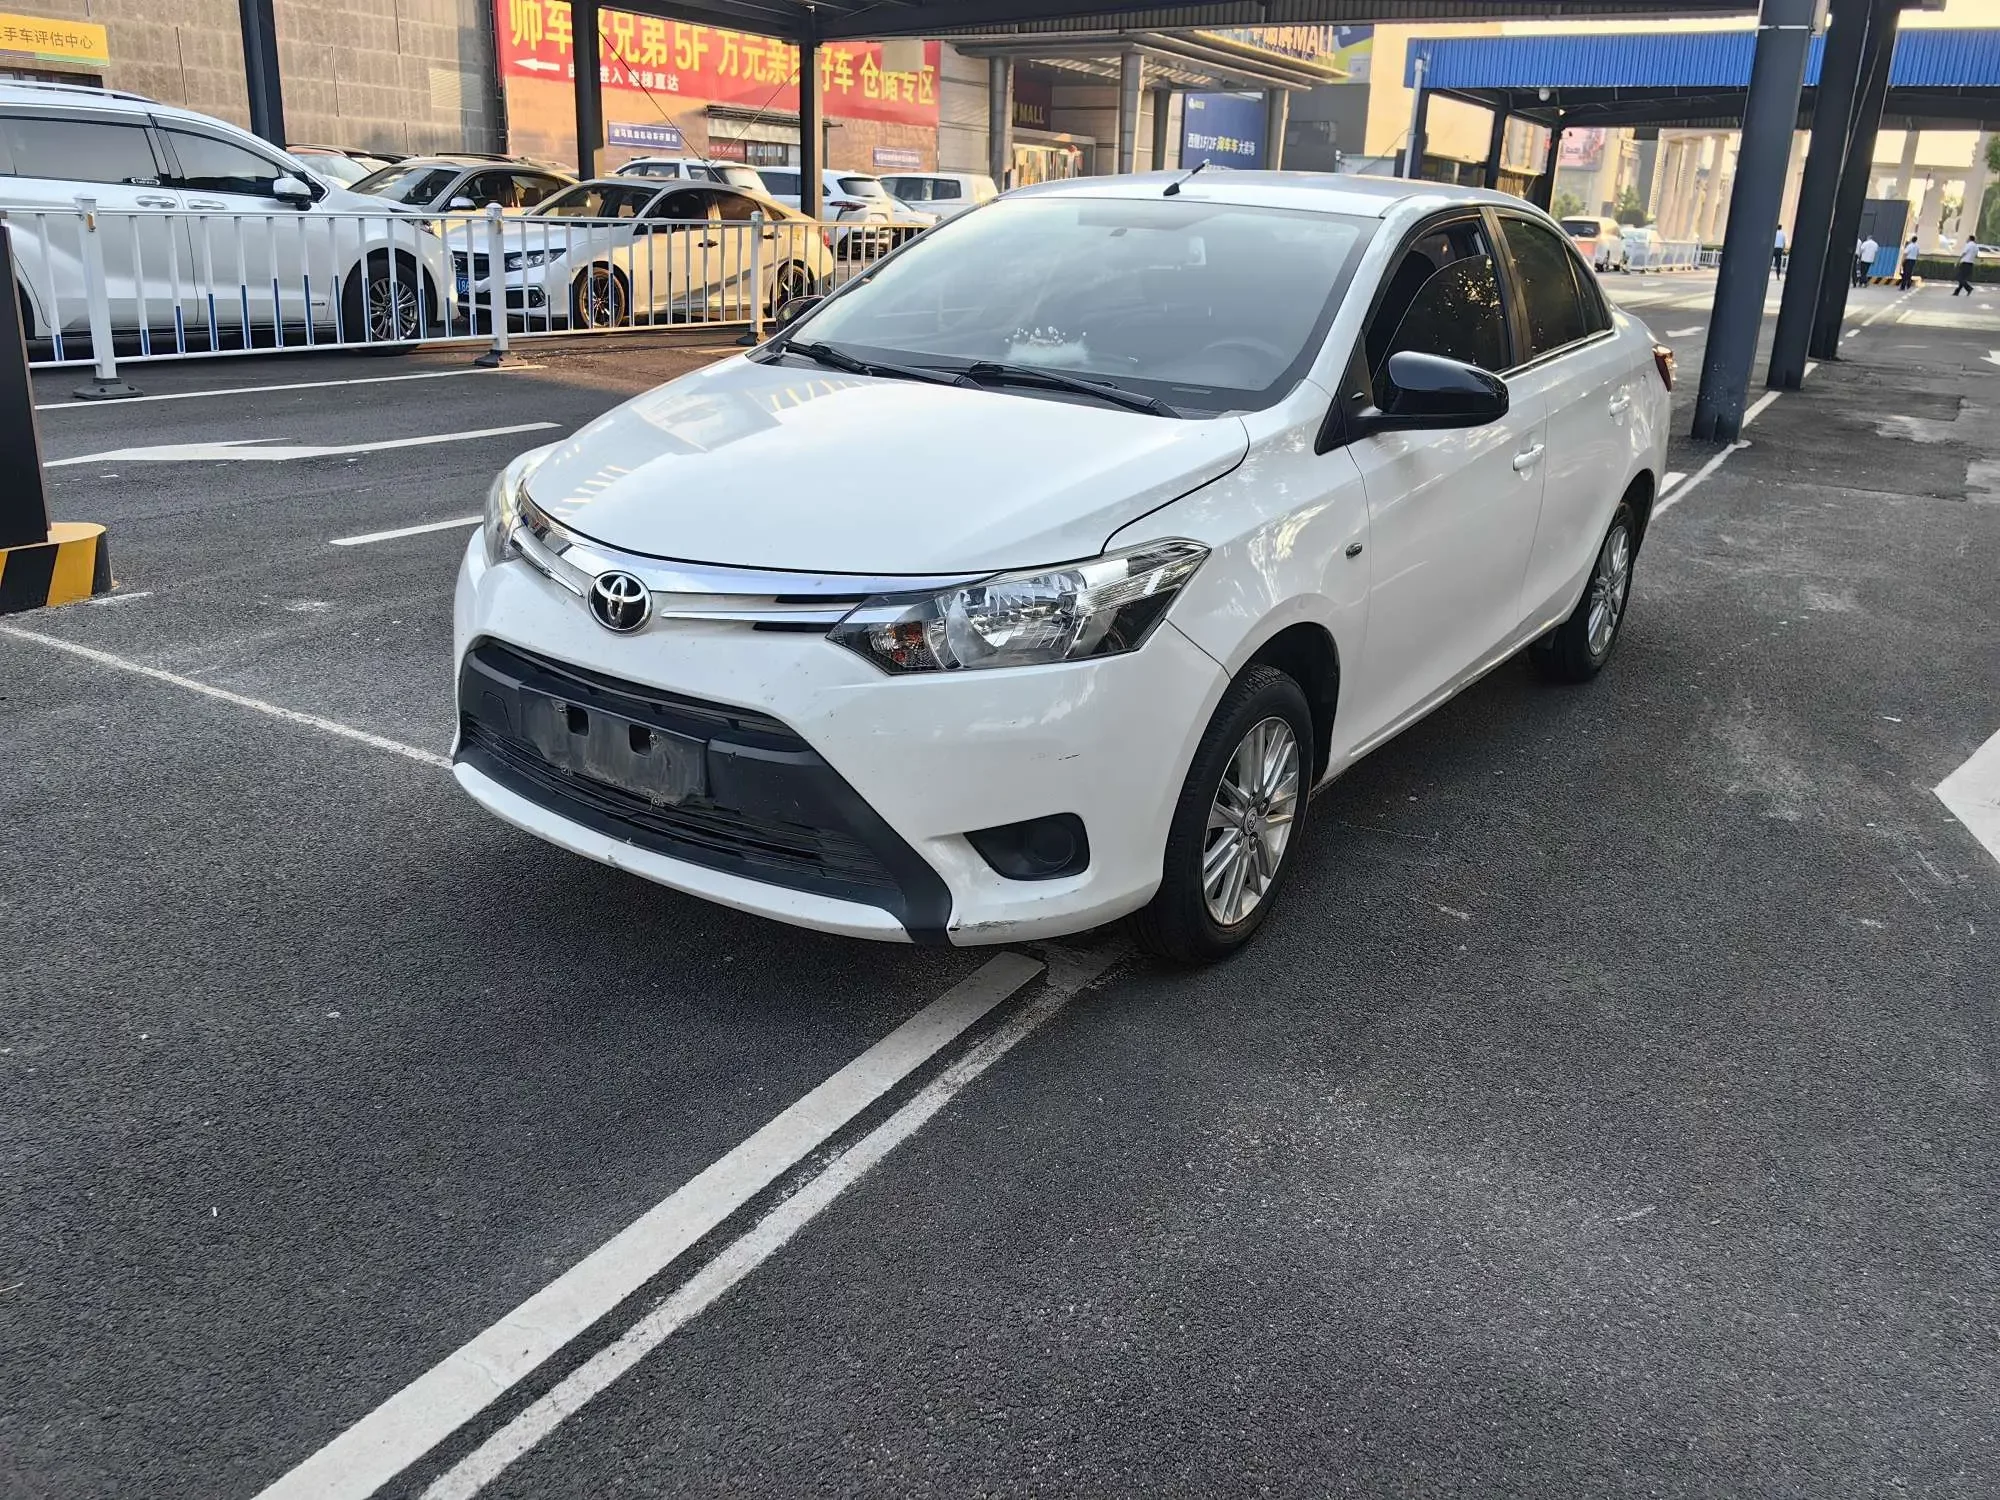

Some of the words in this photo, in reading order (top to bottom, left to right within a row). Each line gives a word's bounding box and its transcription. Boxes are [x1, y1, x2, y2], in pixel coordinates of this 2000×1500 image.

[0, 26, 93, 49] 手车评估中心
